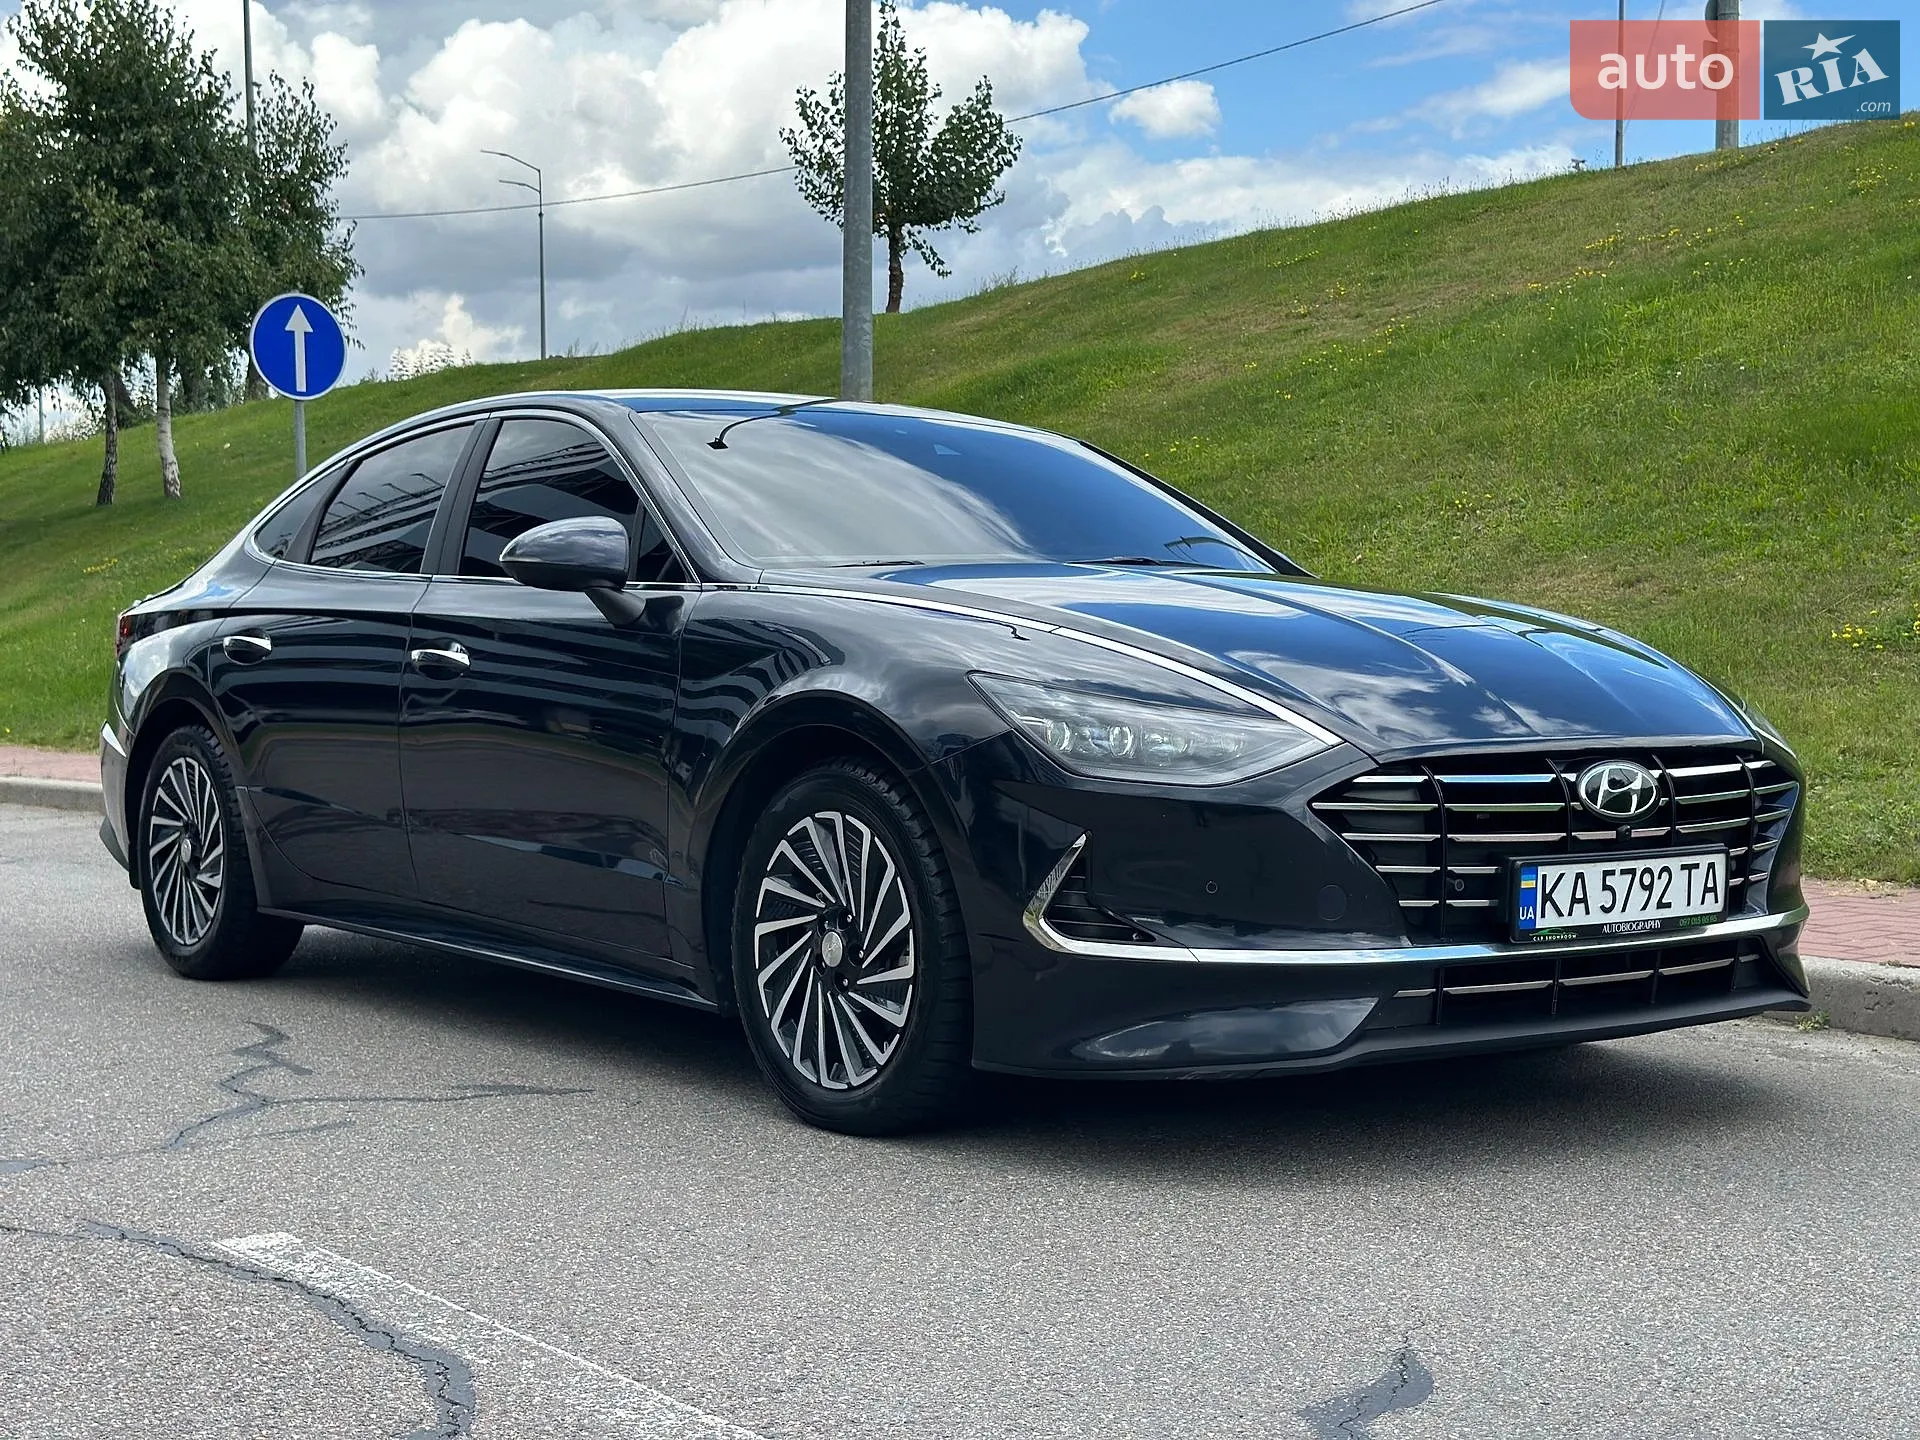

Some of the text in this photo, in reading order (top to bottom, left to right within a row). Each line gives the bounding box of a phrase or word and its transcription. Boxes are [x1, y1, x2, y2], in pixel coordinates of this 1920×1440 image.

[1539, 861, 1720, 919] KA 5792 TA
[1519, 906, 1535, 921] UA
[1601, 919, 1662, 934] AUTOBIOGRAPHY
